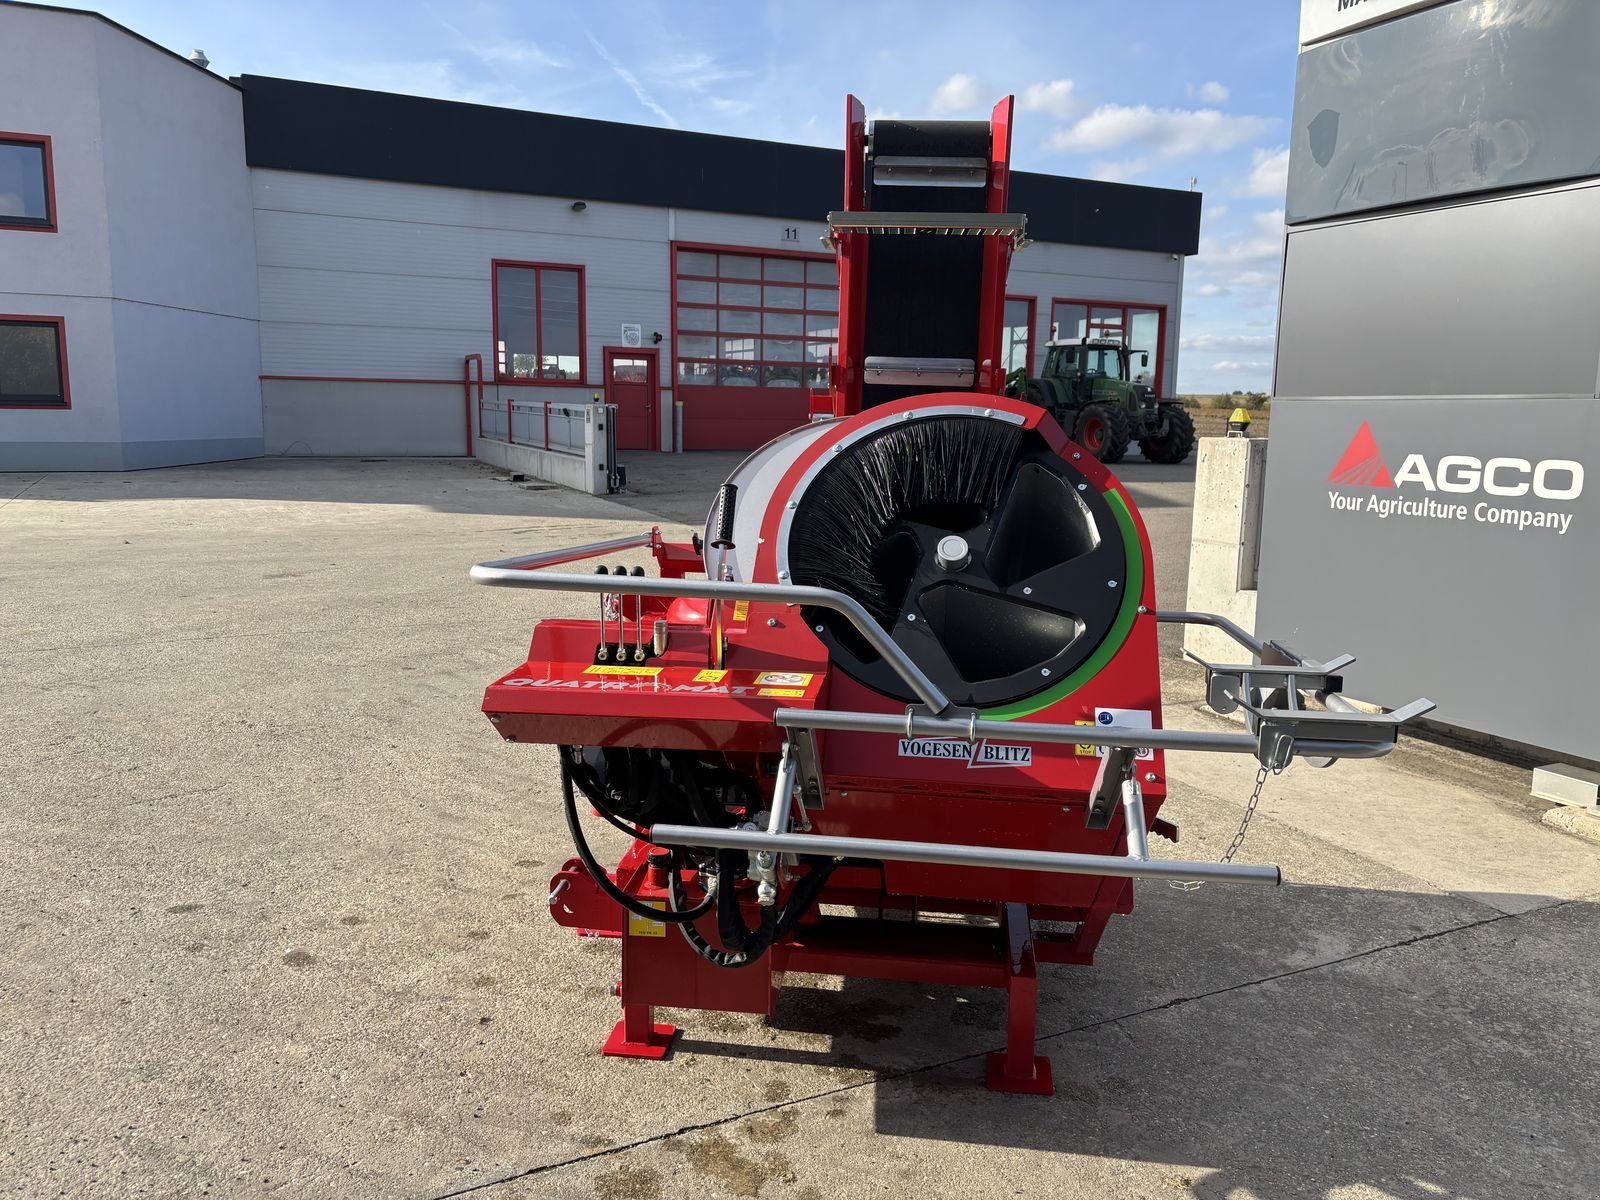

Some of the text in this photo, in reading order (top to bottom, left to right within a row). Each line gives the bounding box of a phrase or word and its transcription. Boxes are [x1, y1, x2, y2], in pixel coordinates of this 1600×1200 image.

[784, 227, 797, 239] 11
[1394, 453, 1585, 500] AGCO
[1328, 491, 1573, 534] Your Agriculture Company
[900, 740, 1031, 762] VOGESEN BLITZ
